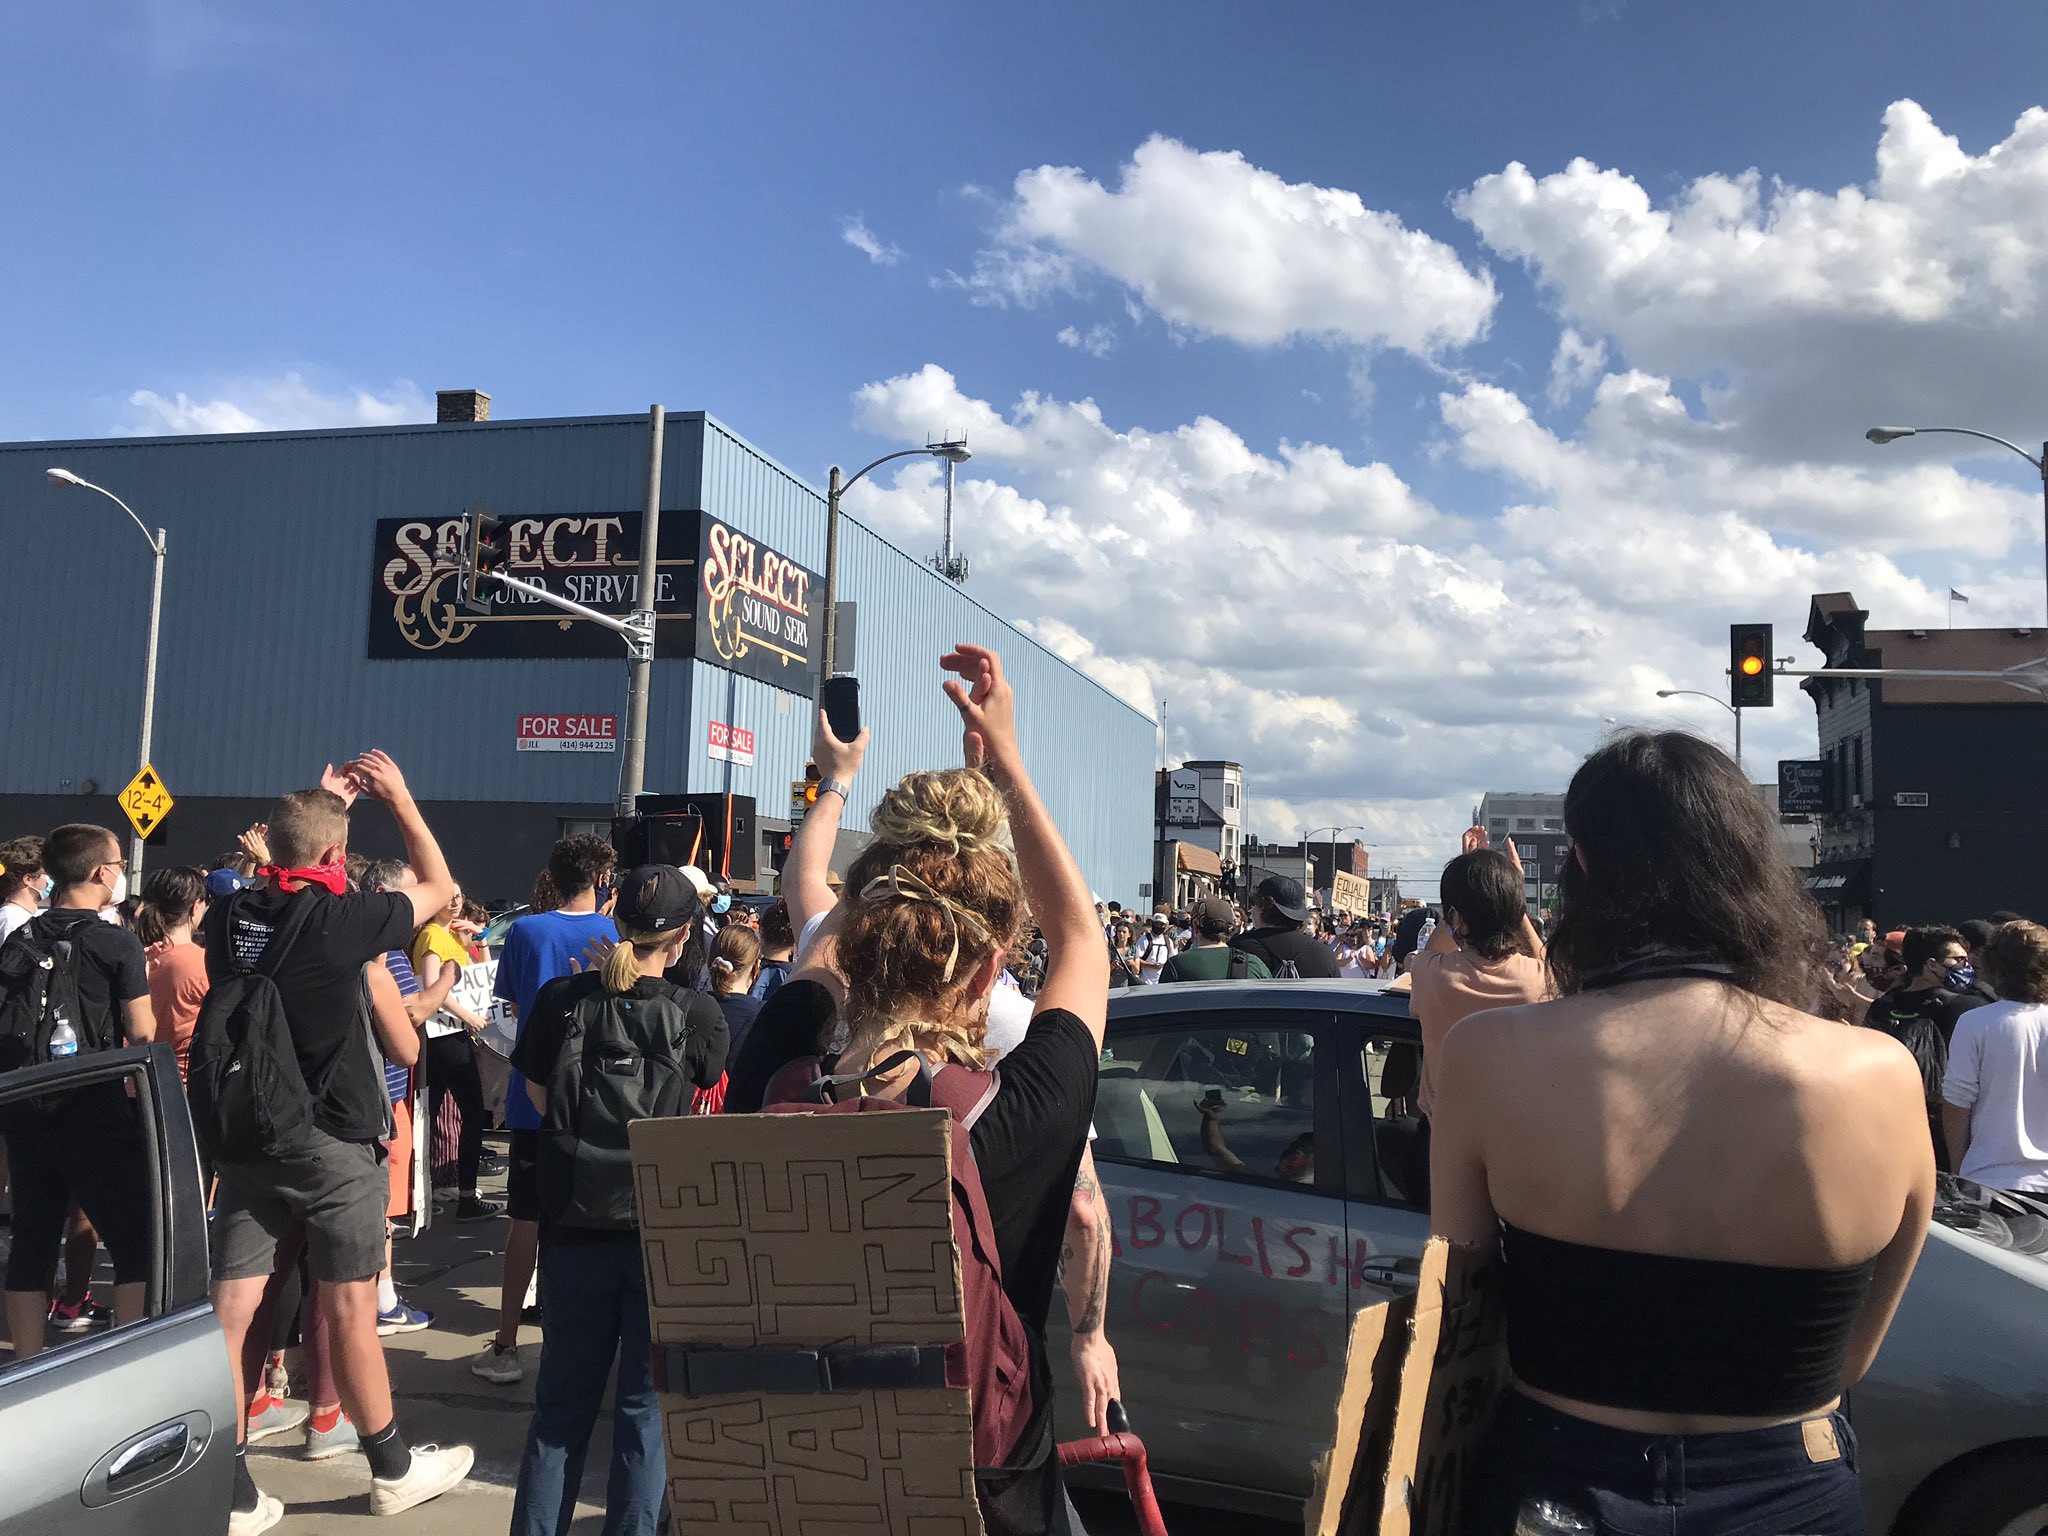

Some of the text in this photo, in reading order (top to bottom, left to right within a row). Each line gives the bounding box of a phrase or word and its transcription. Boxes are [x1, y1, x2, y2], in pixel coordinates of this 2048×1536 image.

[383, 516, 623, 596] SEECT
[704, 523, 809, 614] SELECT
[462, 573, 676, 604] UND SERVIE
[741, 595, 808, 648] SOUND SERV
[522, 717, 613, 736] FOR SALE
[711, 724, 753, 752] FOR SALE
[559, 740, 578, 750] (414)
[579, 741, 594, 749] 944
[595, 742, 614, 750] 2125
[1333, 890, 1367, 912] JUSTICE
